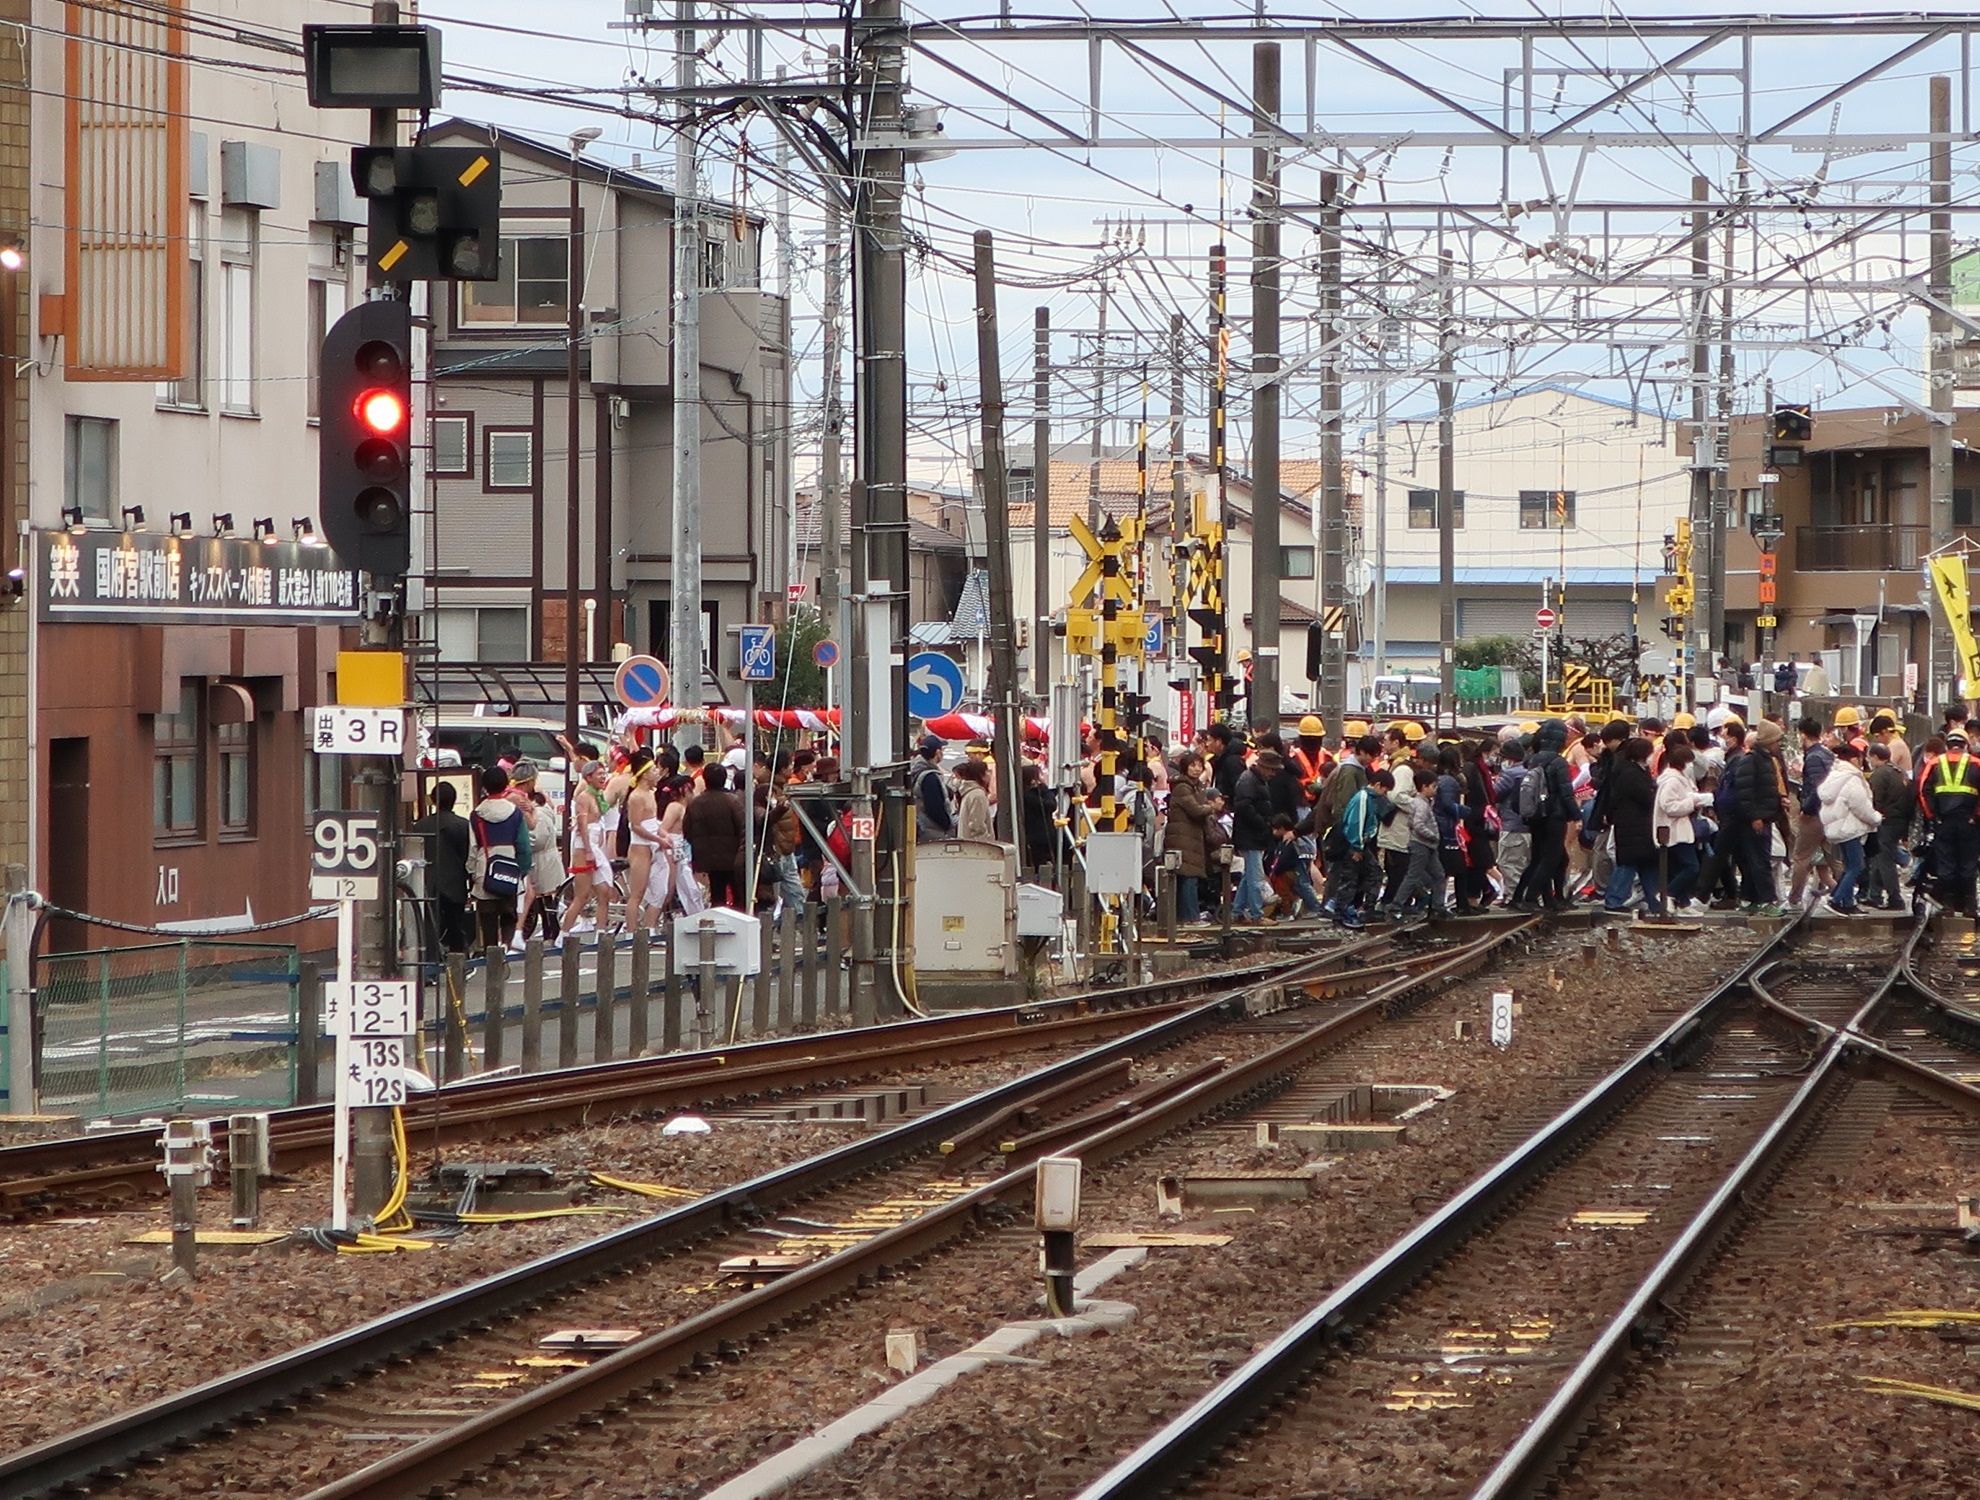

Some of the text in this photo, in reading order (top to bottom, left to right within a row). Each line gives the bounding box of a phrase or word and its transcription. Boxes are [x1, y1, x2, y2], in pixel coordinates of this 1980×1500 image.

[50, 545, 79, 597] 笑笑
[96, 547, 181, 599] 国府宮駅前店
[1758, 617, 1775, 626] 11-2
[318, 714, 398, 748] 出発 3 R
[853, 820, 874, 838] 13
[314, 818, 377, 870] 95
[156, 865, 178, 905] 入口
[335, 880, 356, 896] 12
[350, 984, 408, 1007] 13-1
[350, 1011, 408, 1033] 12-1
